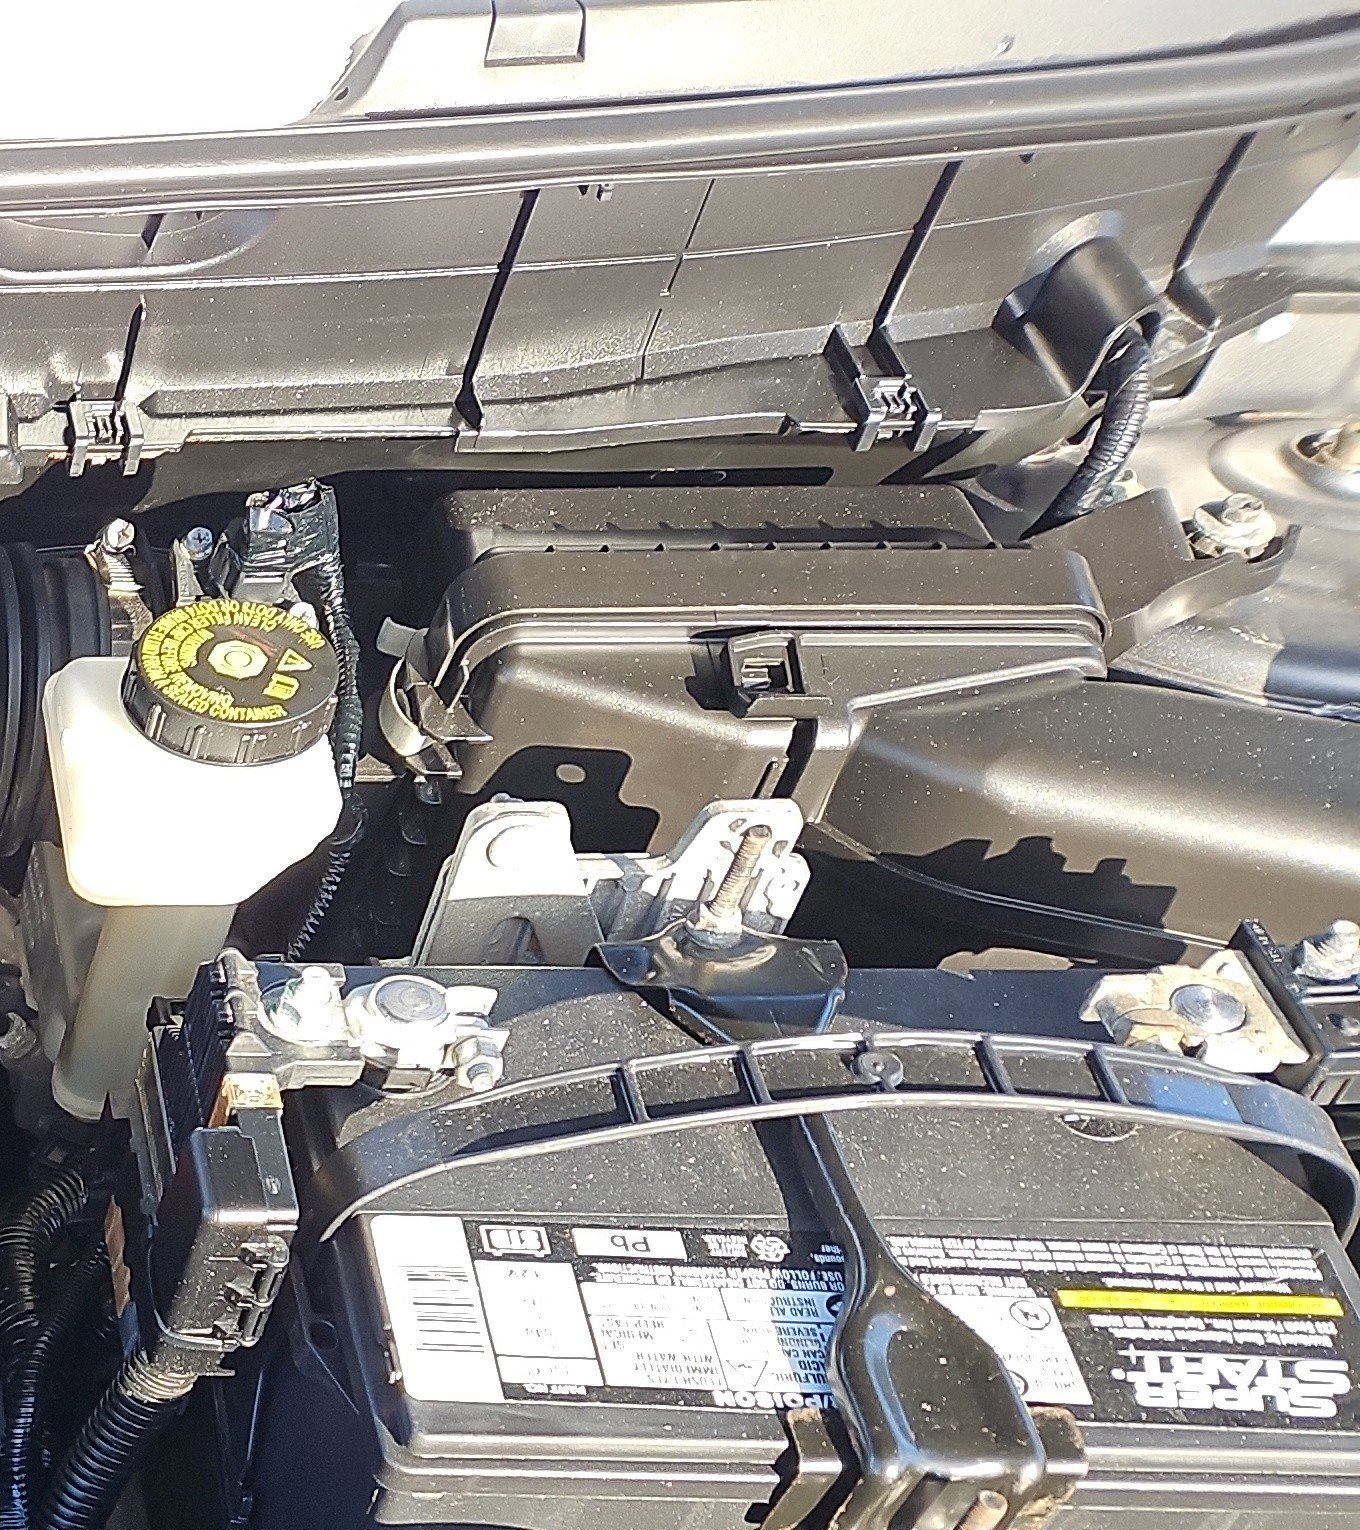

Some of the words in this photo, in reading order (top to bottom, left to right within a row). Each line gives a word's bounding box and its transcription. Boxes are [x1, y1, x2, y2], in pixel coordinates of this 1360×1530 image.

[209, 703, 289, 722] CONTAINER
[610, 1234, 651, 1253] Pb
[789, 1306, 819, 1319] READ
[1126, 1356, 1351, 1396] START
[1133, 1381, 1338, 1419] SUPER
